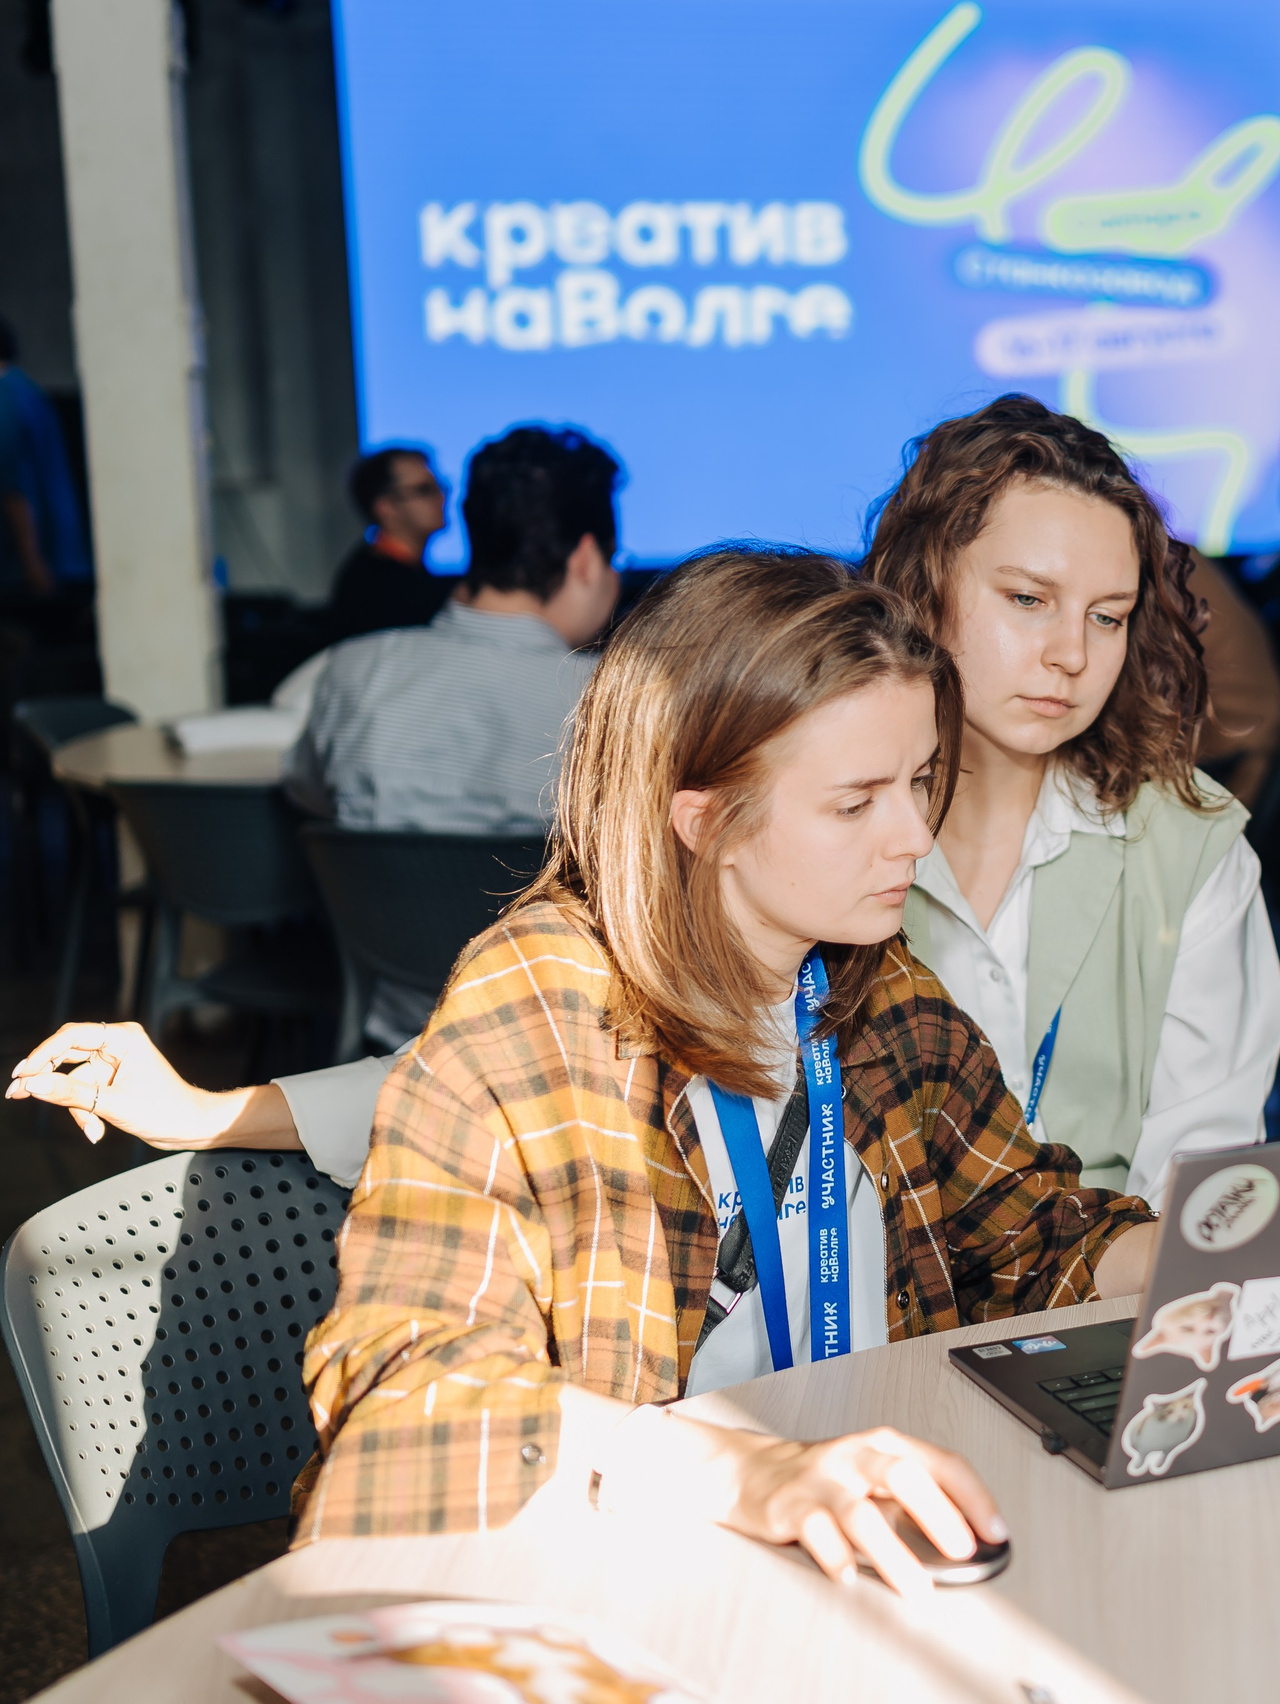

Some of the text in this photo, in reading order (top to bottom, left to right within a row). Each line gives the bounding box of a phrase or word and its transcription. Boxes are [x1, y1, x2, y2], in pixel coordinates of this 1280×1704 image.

[420, 201, 847, 291] креатив
[802, 962, 820, 1011] УЧАС
[811, 1032, 825, 1086] креати
[822, 1103, 835, 1210] УЧАСТНИК
[820, 1228, 832, 1283] креатив
[823, 1301, 838, 1358] ТНИК
